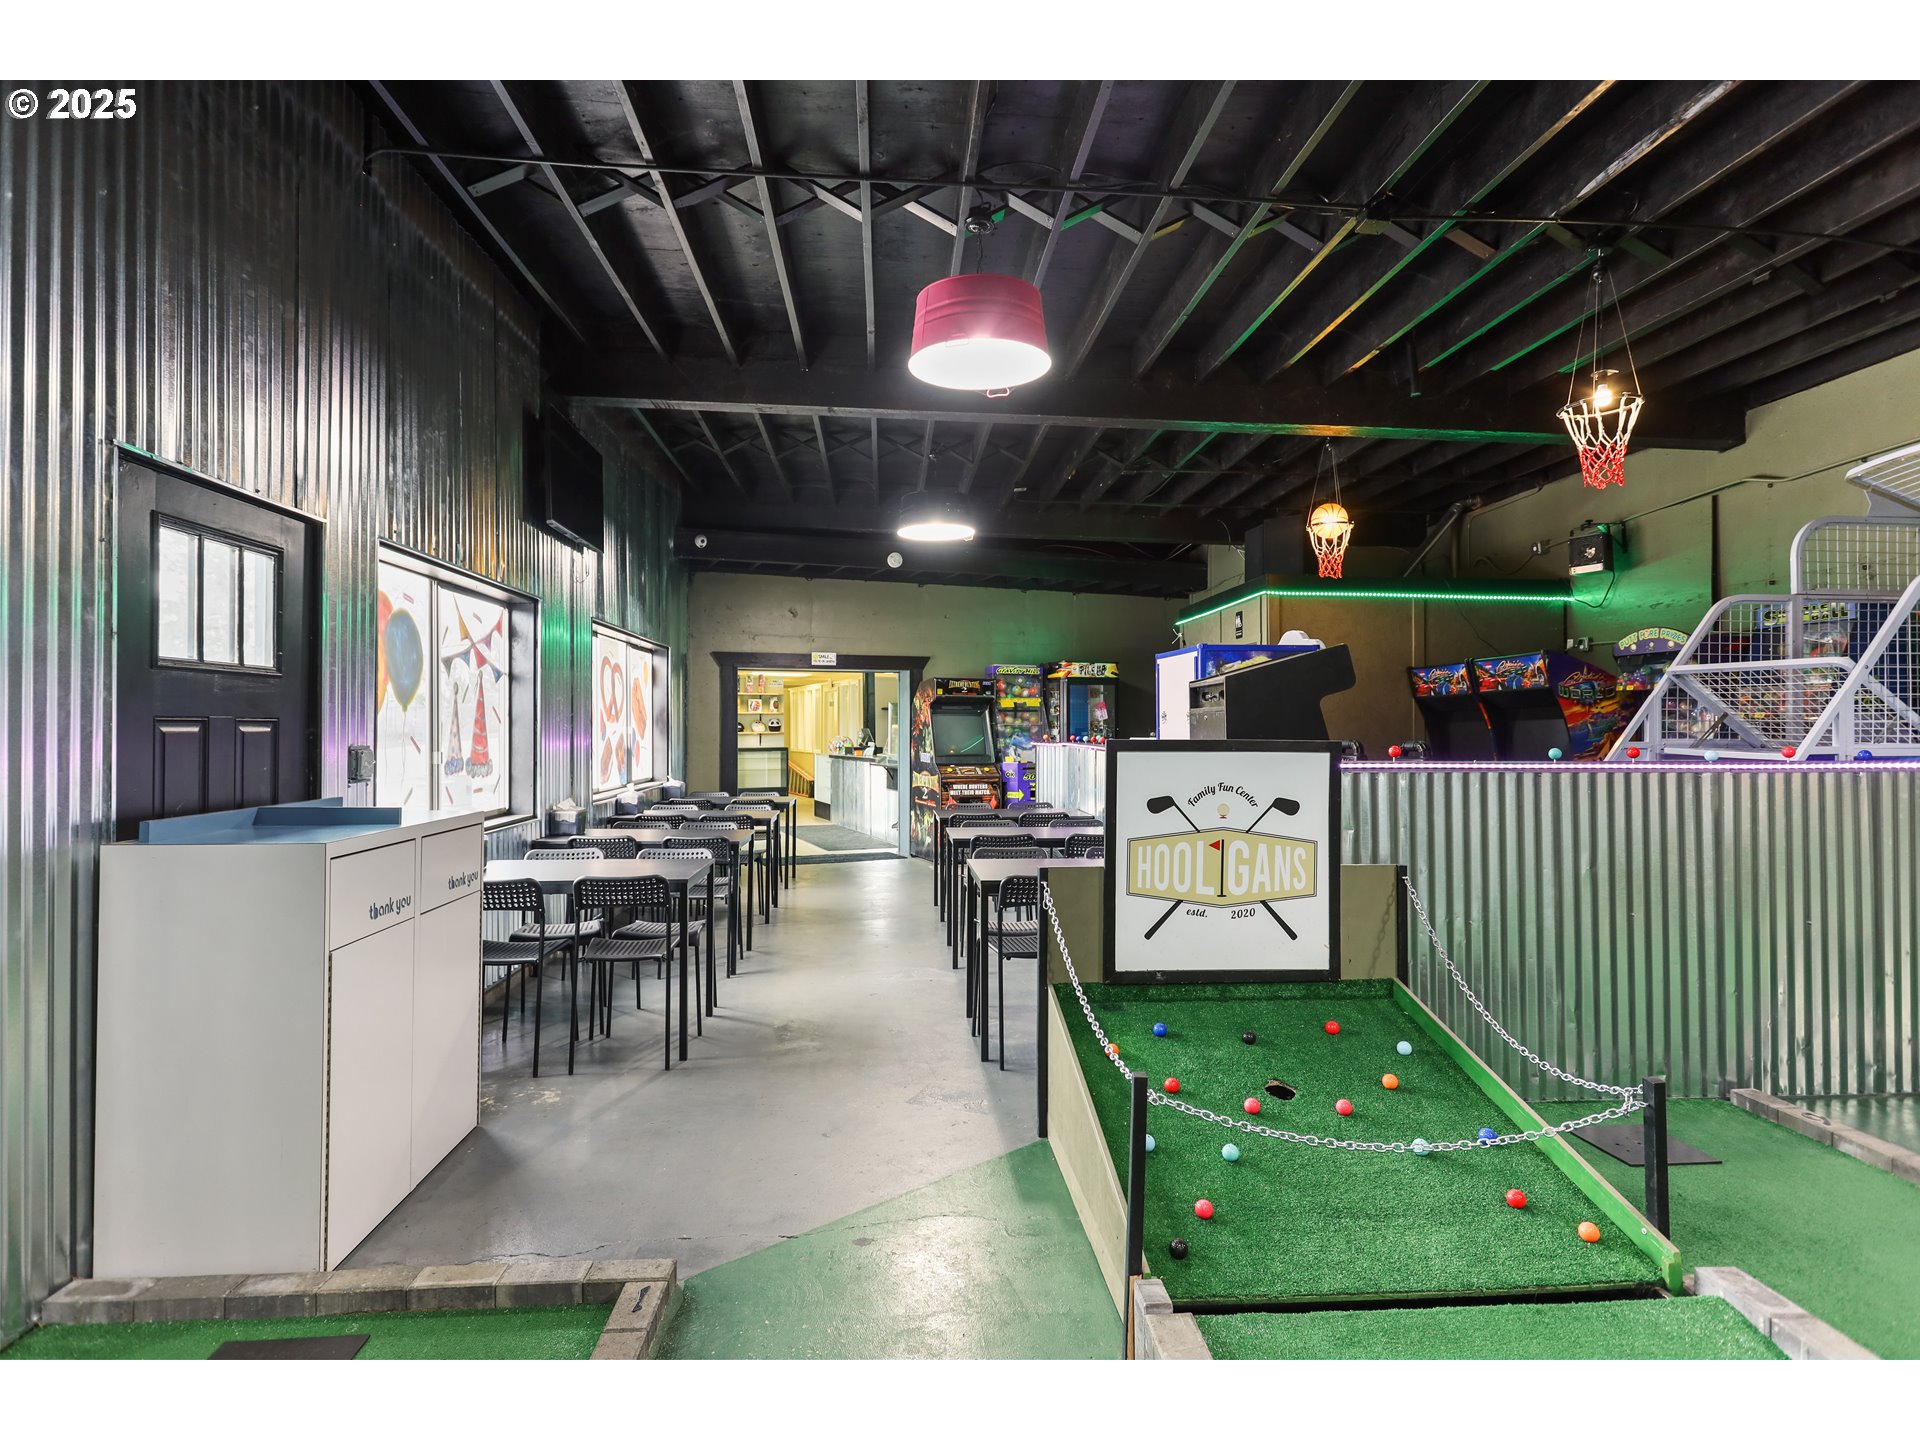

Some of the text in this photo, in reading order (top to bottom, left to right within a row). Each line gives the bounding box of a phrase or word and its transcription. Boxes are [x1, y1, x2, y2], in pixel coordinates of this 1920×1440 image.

[1619, 628, 1688, 650] PUTT FORE PRIZES
[1558, 682, 1616, 699] WORLD
[1188, 782, 1259, 808] Family Fun Center
[1136, 838, 1307, 898] HOOLIGANS
[447, 870, 479, 890] thank you
[369, 895, 412, 920] thank you
[1186, 907, 1256, 920] estd. 2020
